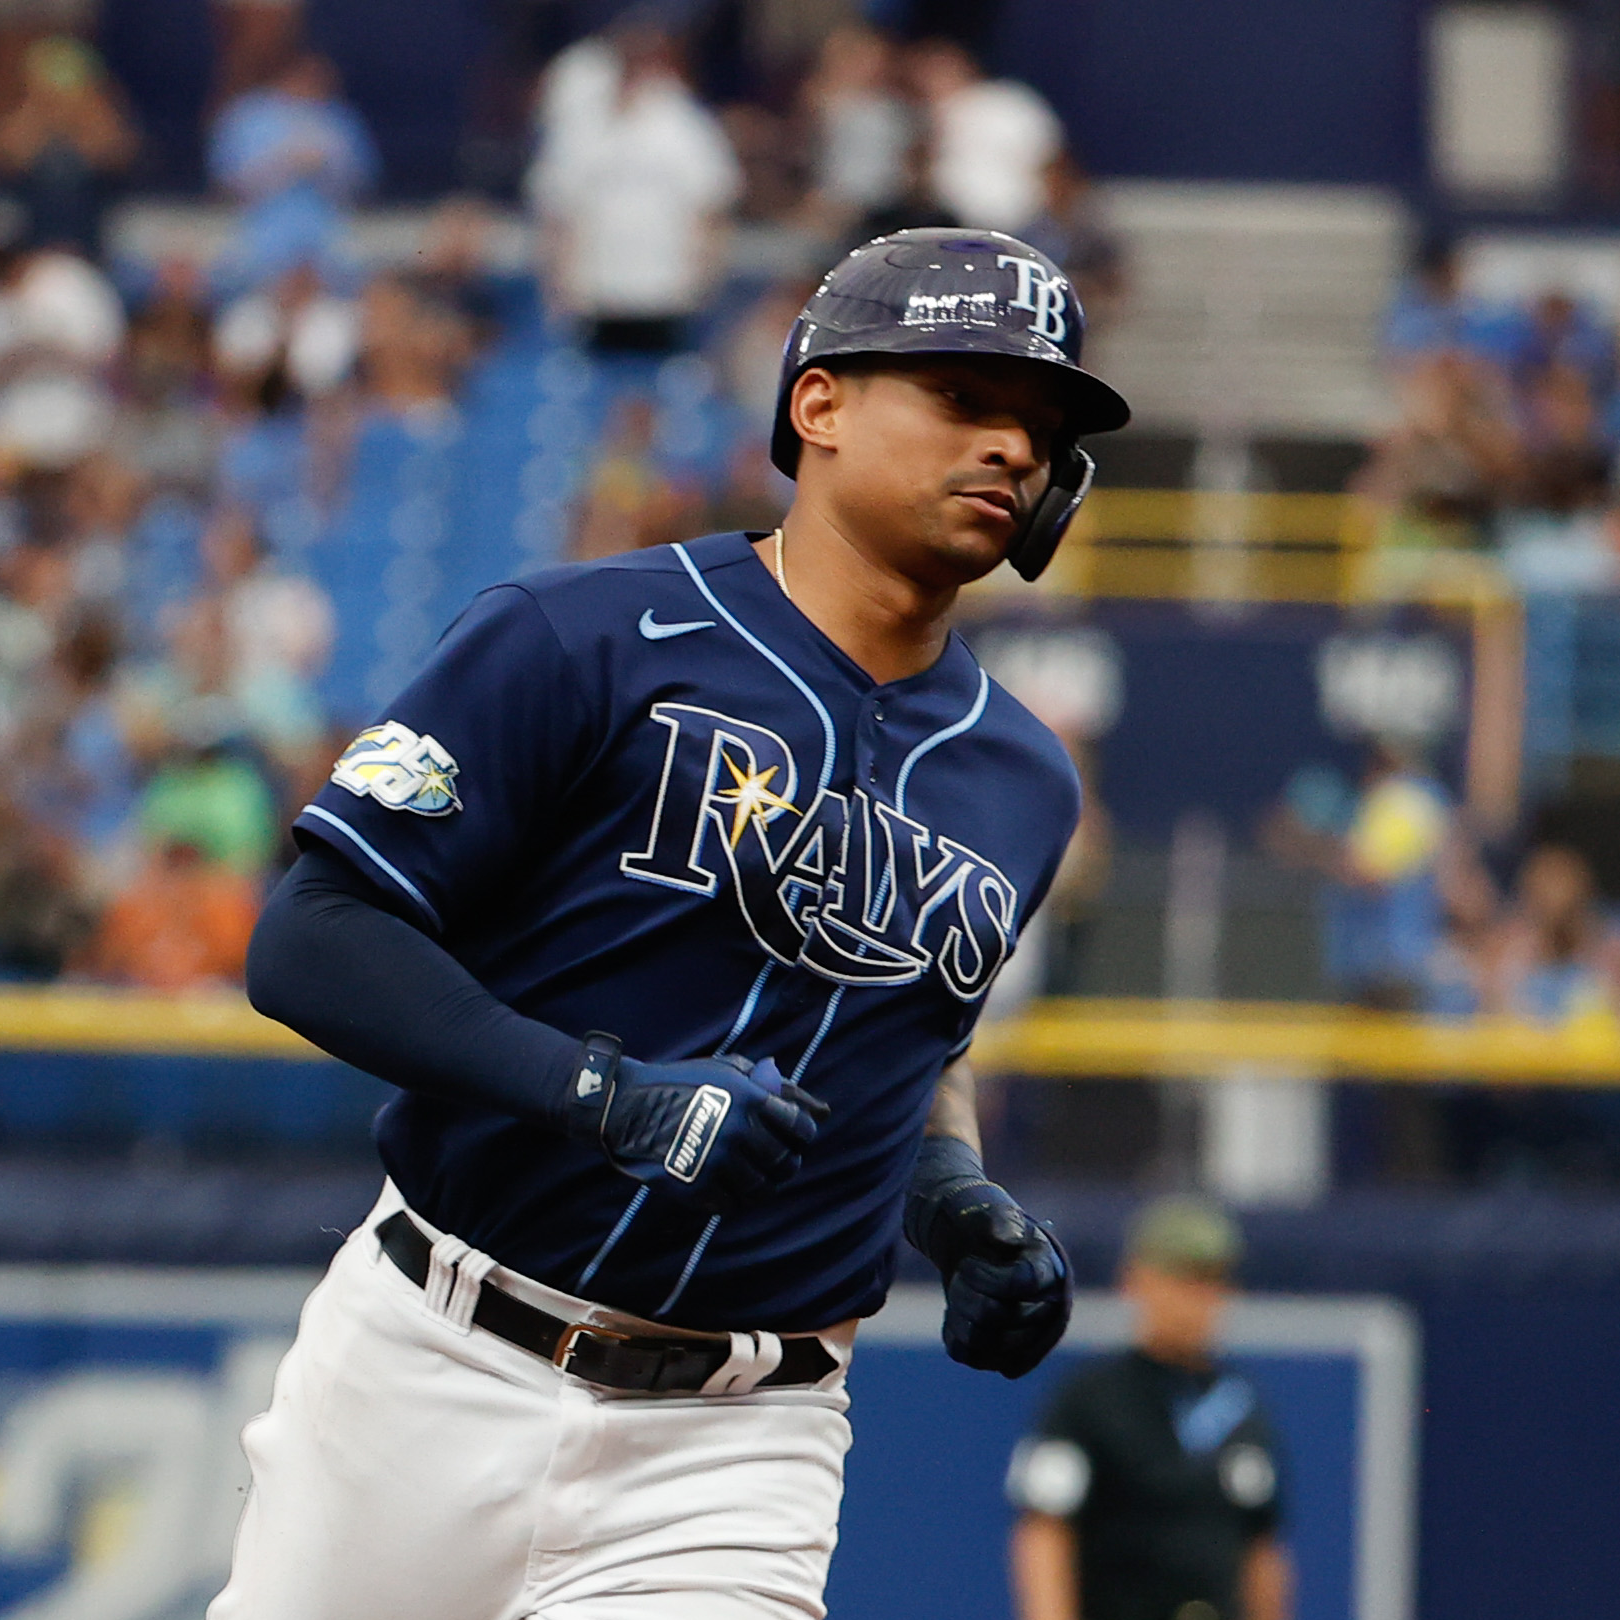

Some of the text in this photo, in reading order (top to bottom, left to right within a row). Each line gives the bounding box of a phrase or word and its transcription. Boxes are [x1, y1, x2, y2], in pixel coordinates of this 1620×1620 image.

[997, 254, 1067, 342] TB
[330, 719, 460, 811] 25
[673, 1091, 722, 1174] Franklin
